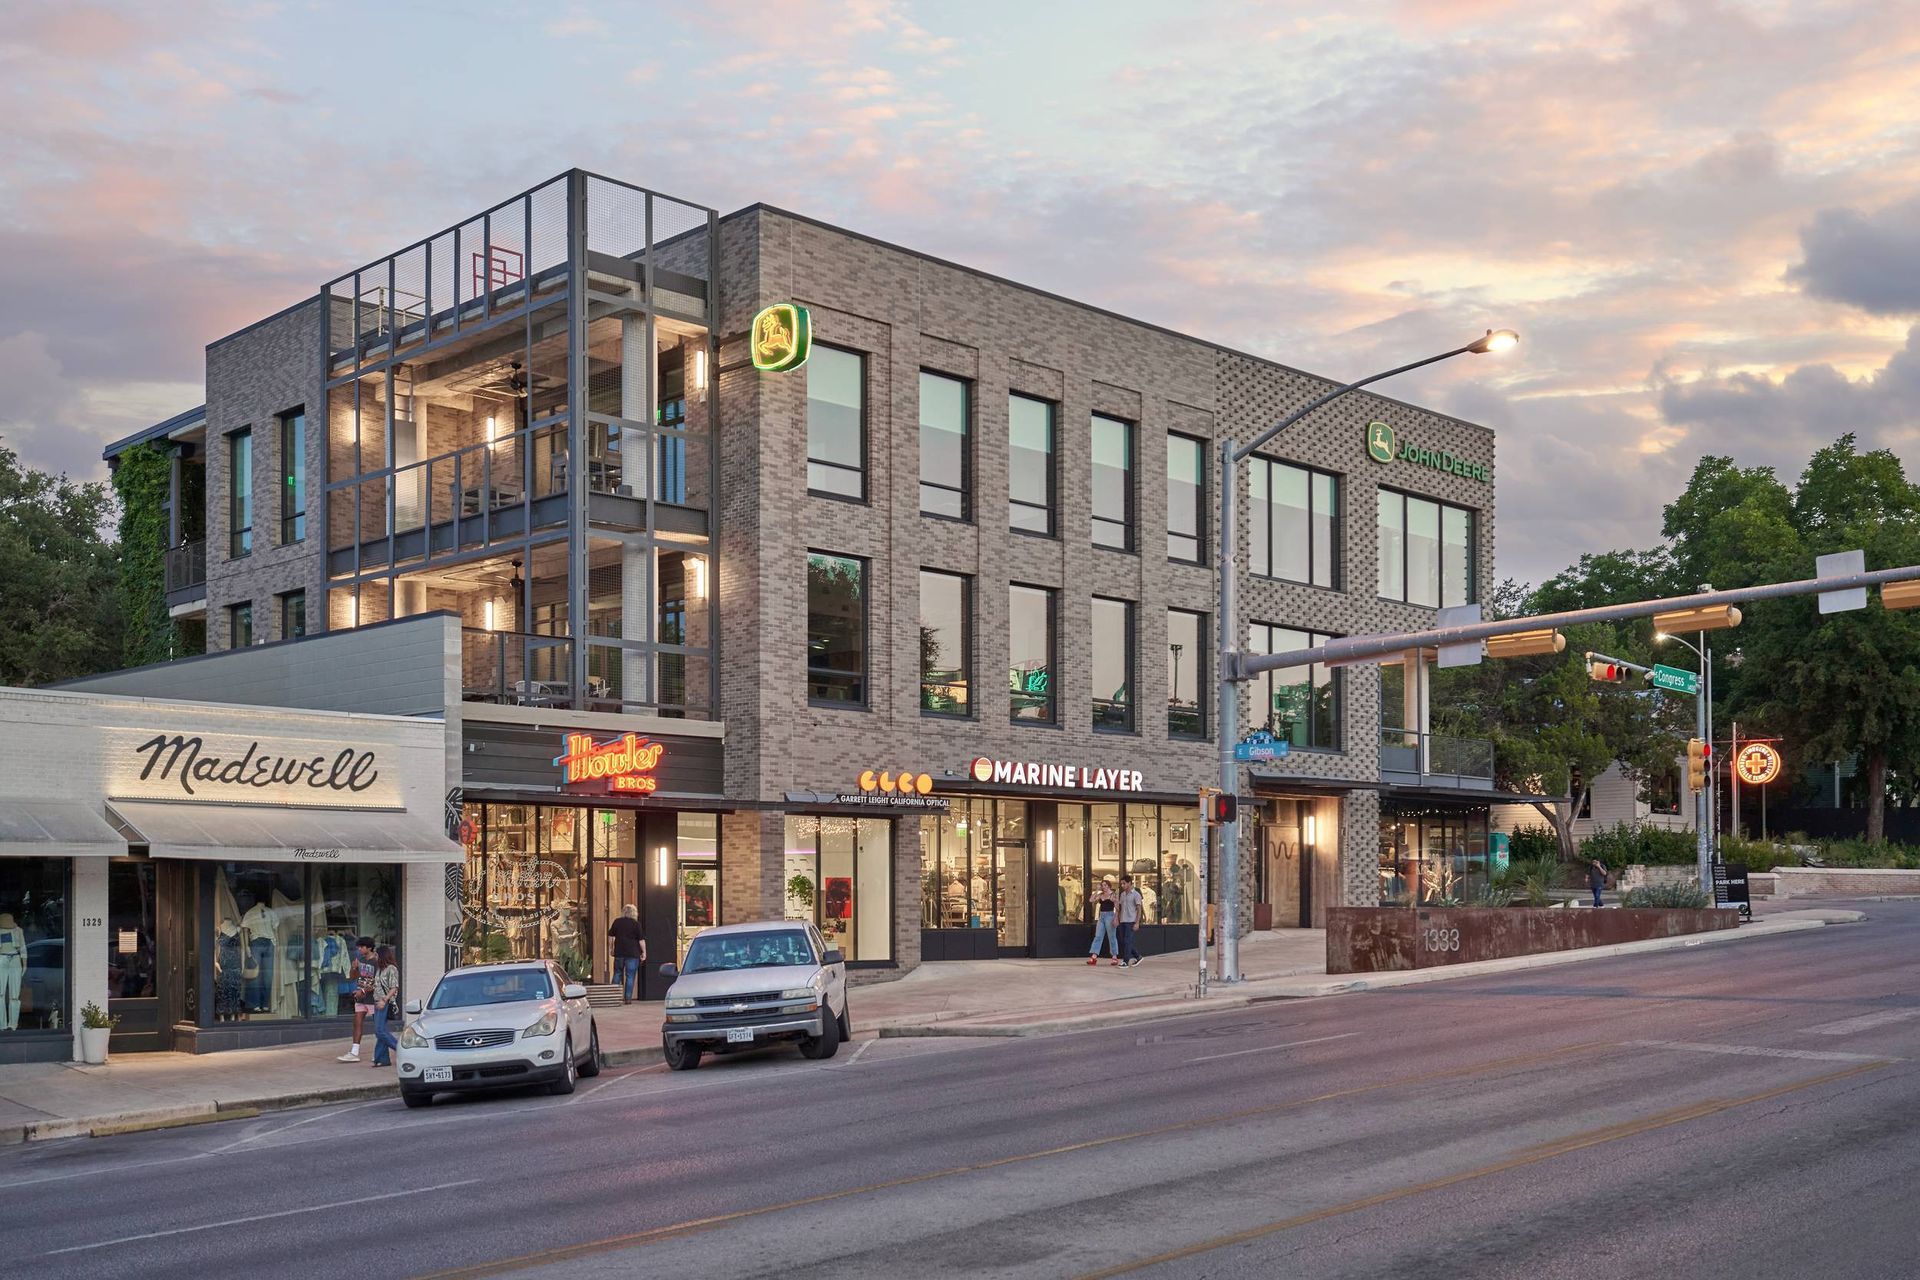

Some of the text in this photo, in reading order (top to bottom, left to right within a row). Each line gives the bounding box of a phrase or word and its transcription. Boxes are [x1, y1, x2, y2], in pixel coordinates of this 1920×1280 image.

[1397, 439, 1490, 482] JOHN DEERE
[1658, 669, 1685, 687] Congress
[560, 732, 664, 783] Howler
[1249, 747, 1274, 755] Gibson
[136, 734, 379, 795] Madewell
[616, 776, 656, 791] BROS
[994, 760, 1143, 791] MARINE LAYER
[840, 795, 950, 807] GARRETT LEIGHT CALIFORNIA OPTICAL
[294, 848, 340, 860] Madewell
[82, 918, 102, 927] 1329
[1423, 928, 1460, 952] 1333
